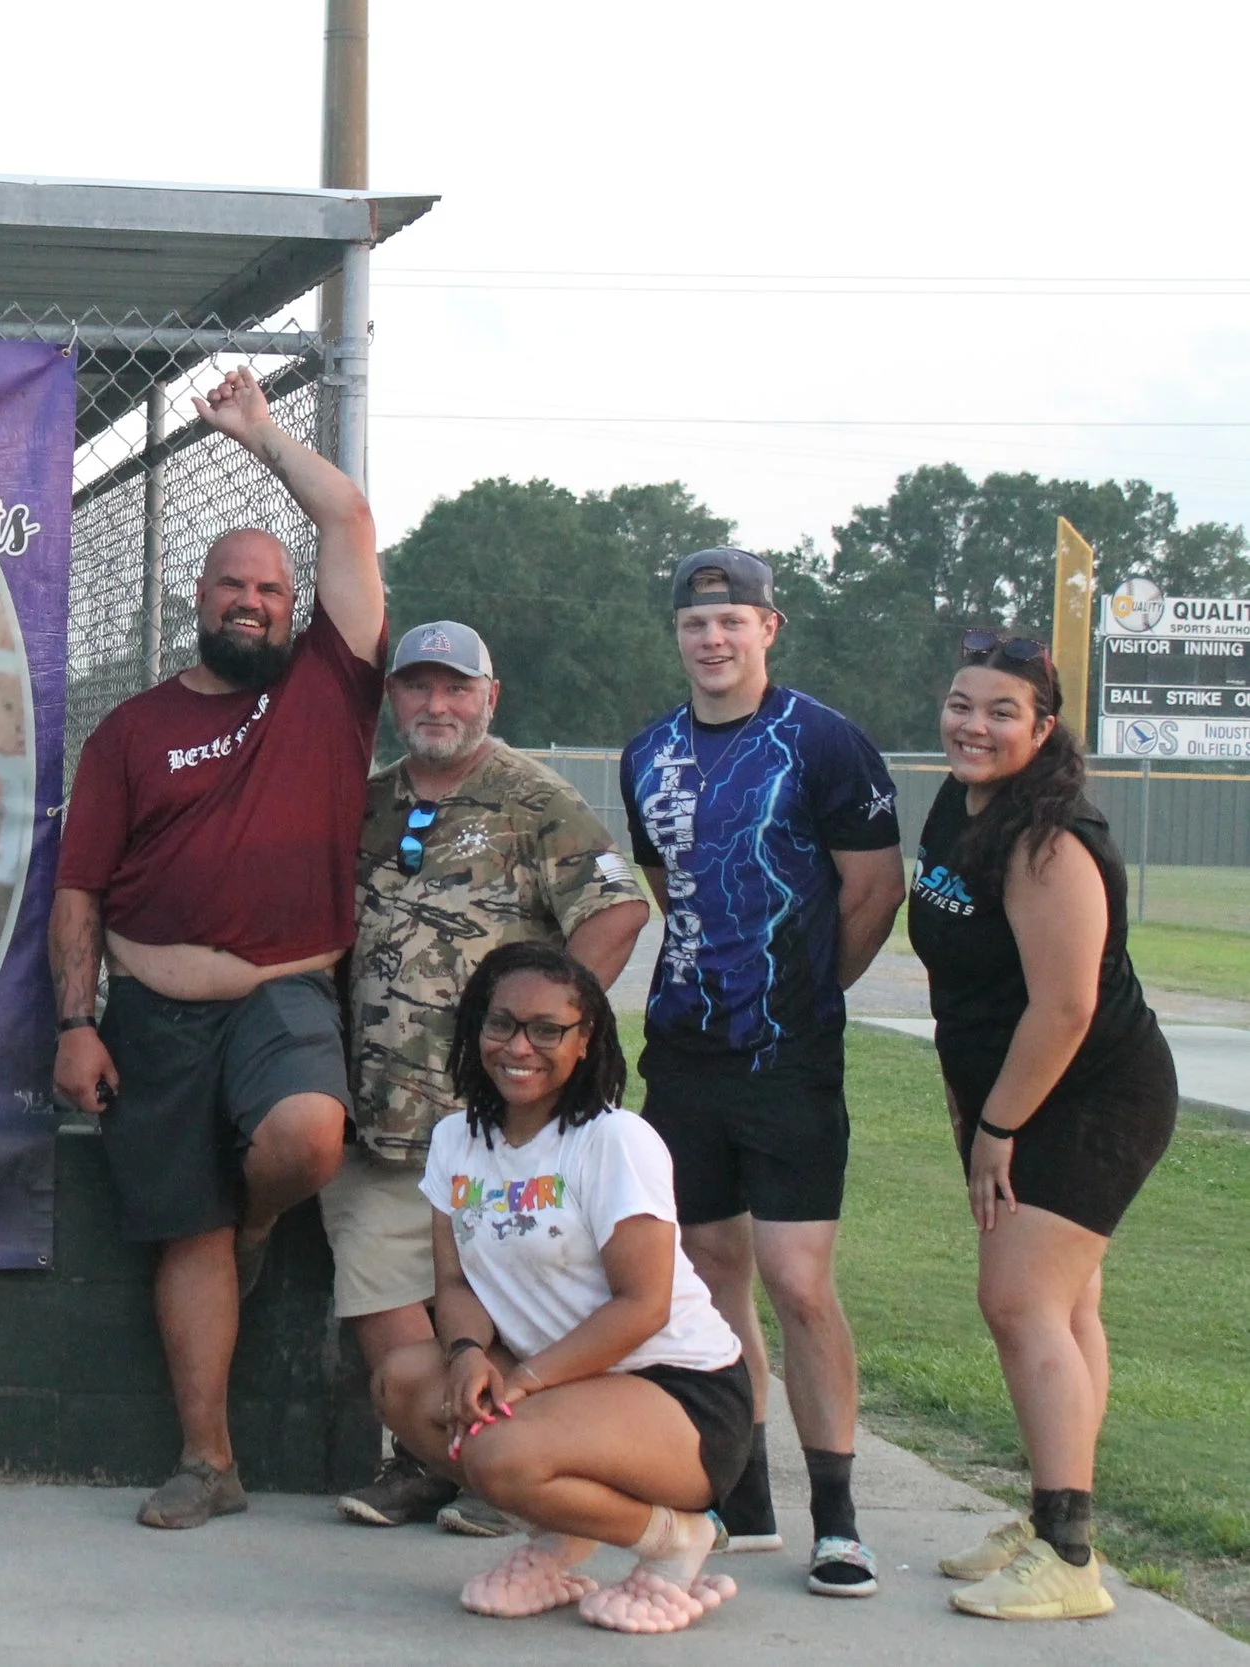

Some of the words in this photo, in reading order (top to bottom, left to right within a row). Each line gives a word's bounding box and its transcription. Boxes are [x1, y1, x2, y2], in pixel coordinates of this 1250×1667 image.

[1170, 624, 1211, 634] SPORTS
[1109, 640, 1170, 654] VISITOR
[1184, 640, 1244, 656] INNING
[1111, 689, 1152, 704] BALL
[1166, 690, 1222, 706] STRIKE
[1205, 723, 1250, 739] INDUST
